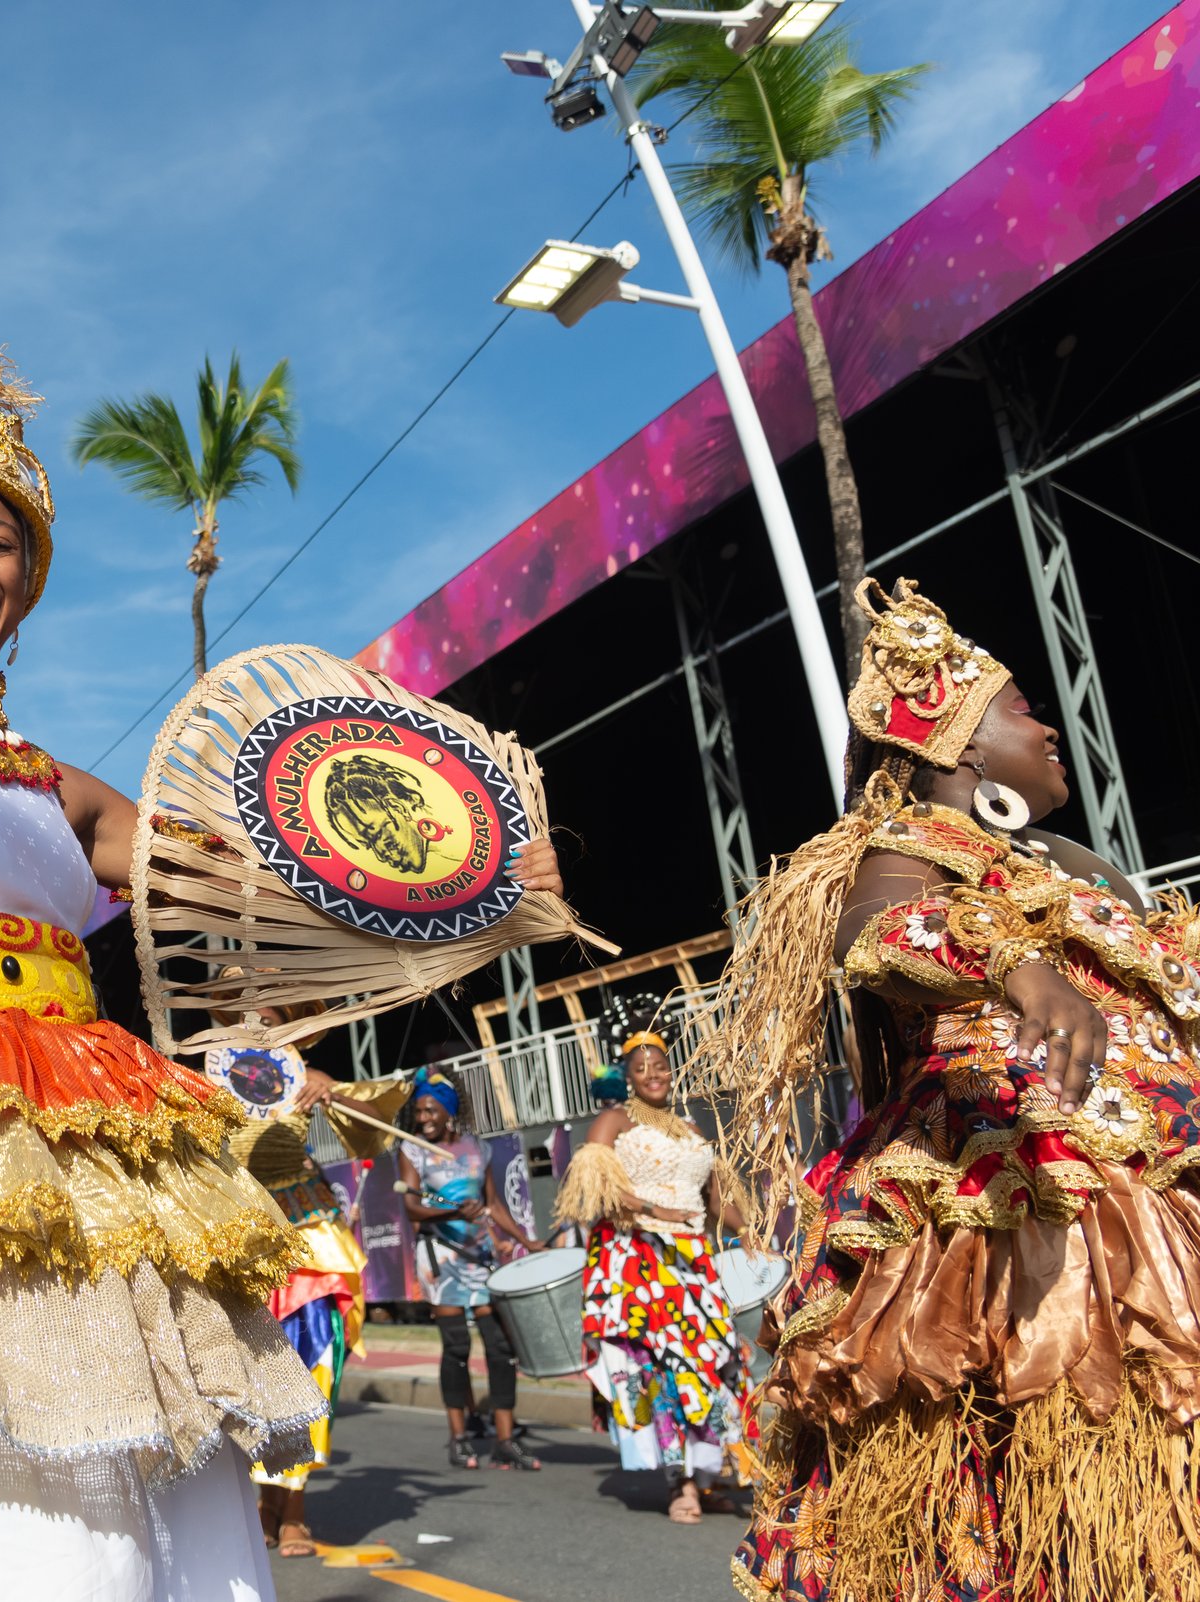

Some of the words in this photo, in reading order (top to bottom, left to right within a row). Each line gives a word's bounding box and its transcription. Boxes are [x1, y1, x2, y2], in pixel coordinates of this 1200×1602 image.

[406, 886, 424, 902] A
[424, 870, 478, 902] NOVA
[461, 790, 493, 872] GERAÇÃO
